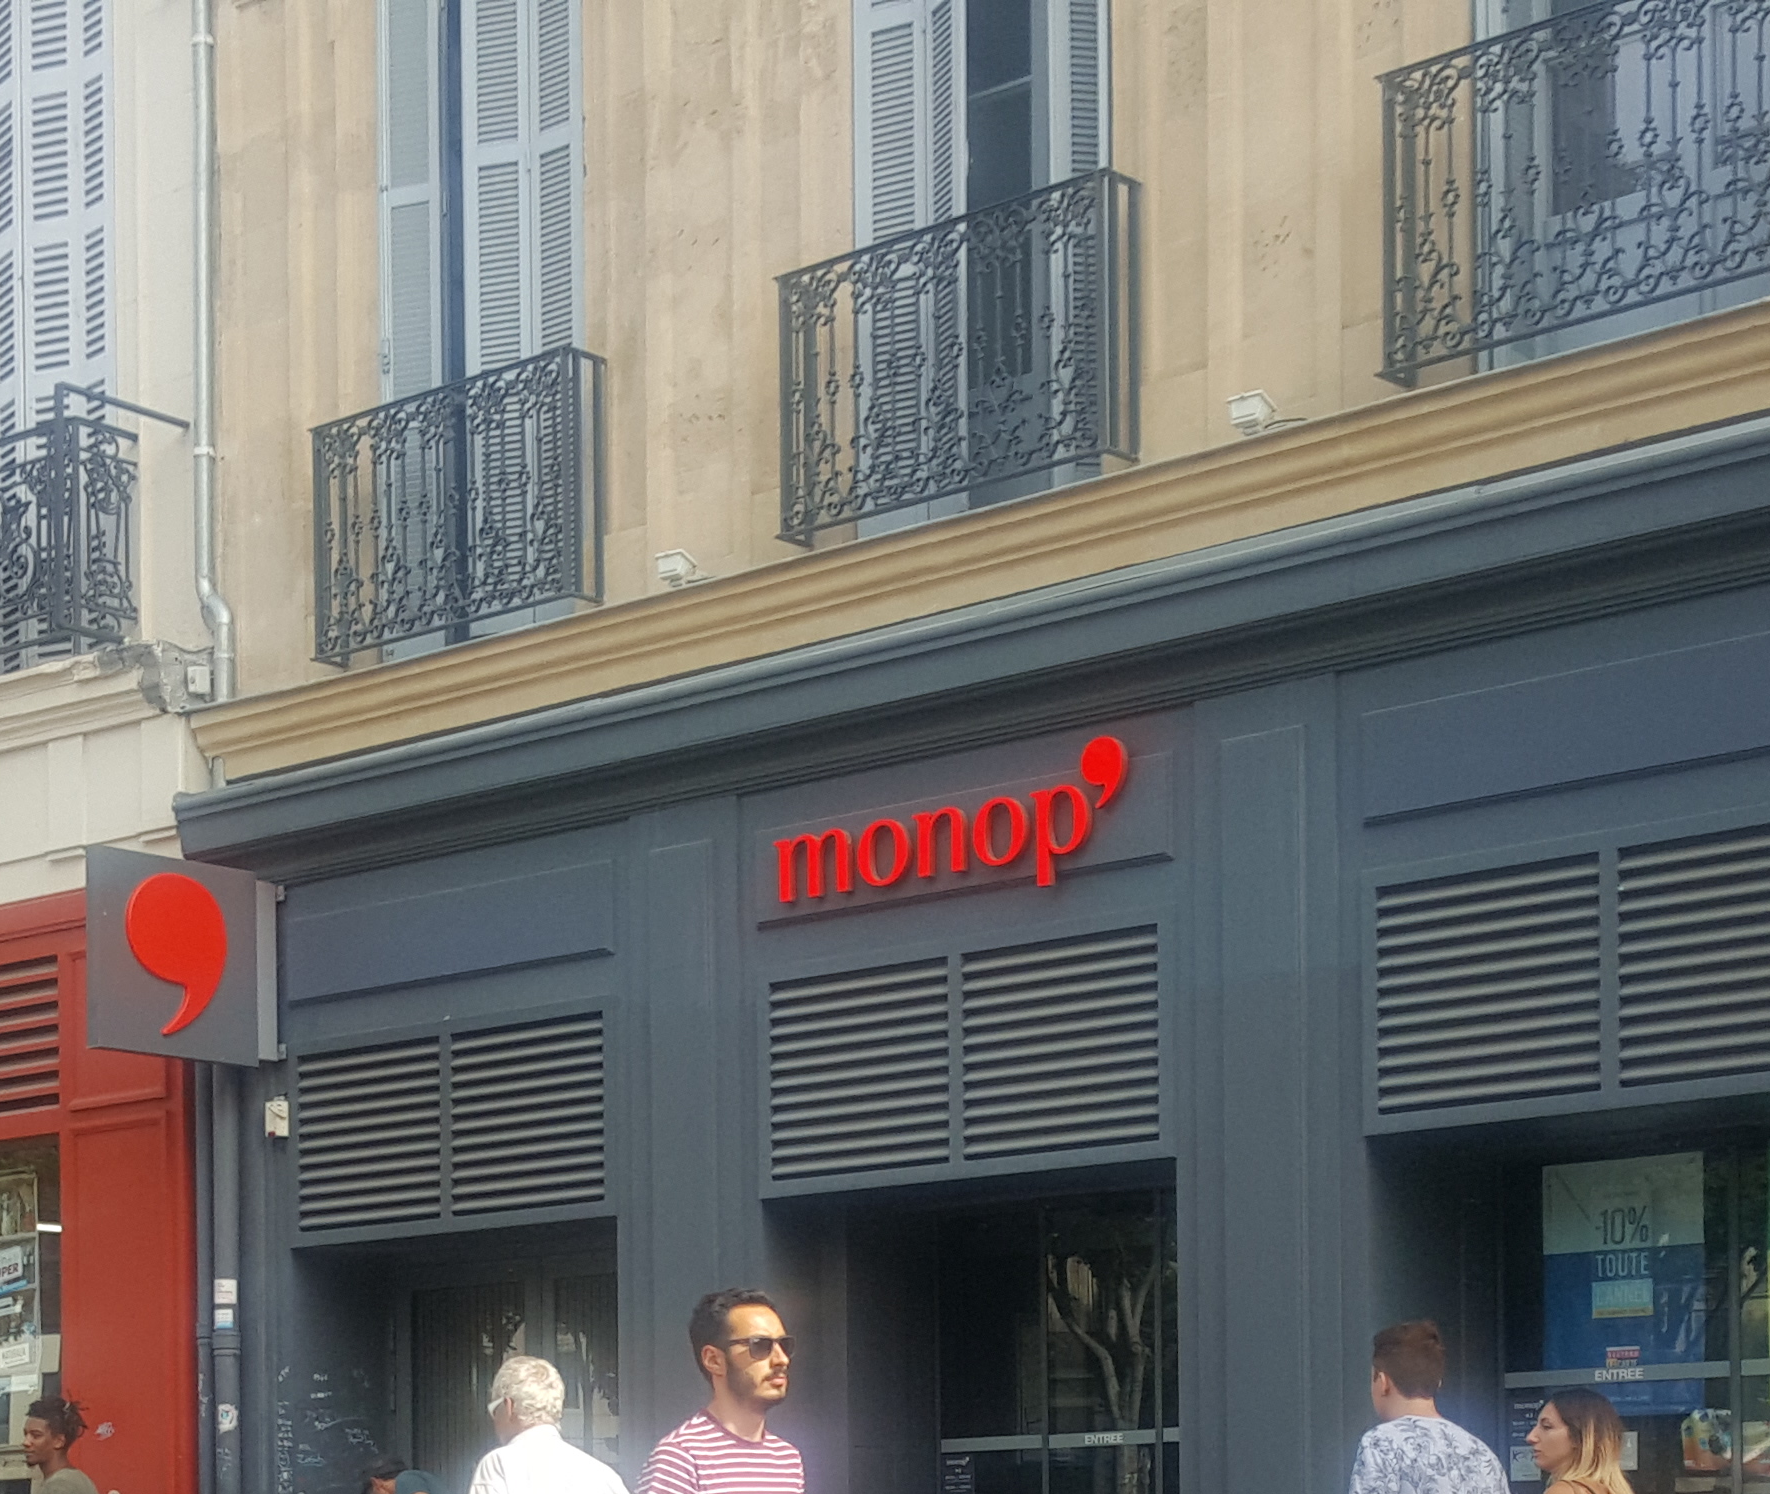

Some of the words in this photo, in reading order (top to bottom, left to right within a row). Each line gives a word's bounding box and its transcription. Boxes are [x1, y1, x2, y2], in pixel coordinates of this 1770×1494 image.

[1595, 1205, 1649, 1245] -10%
[1596, 1252, 1649, 1278] TOUTE
[1594, 1368, 1645, 1381] ENTREE
[1085, 1432, 1124, 1444] ENTREE
